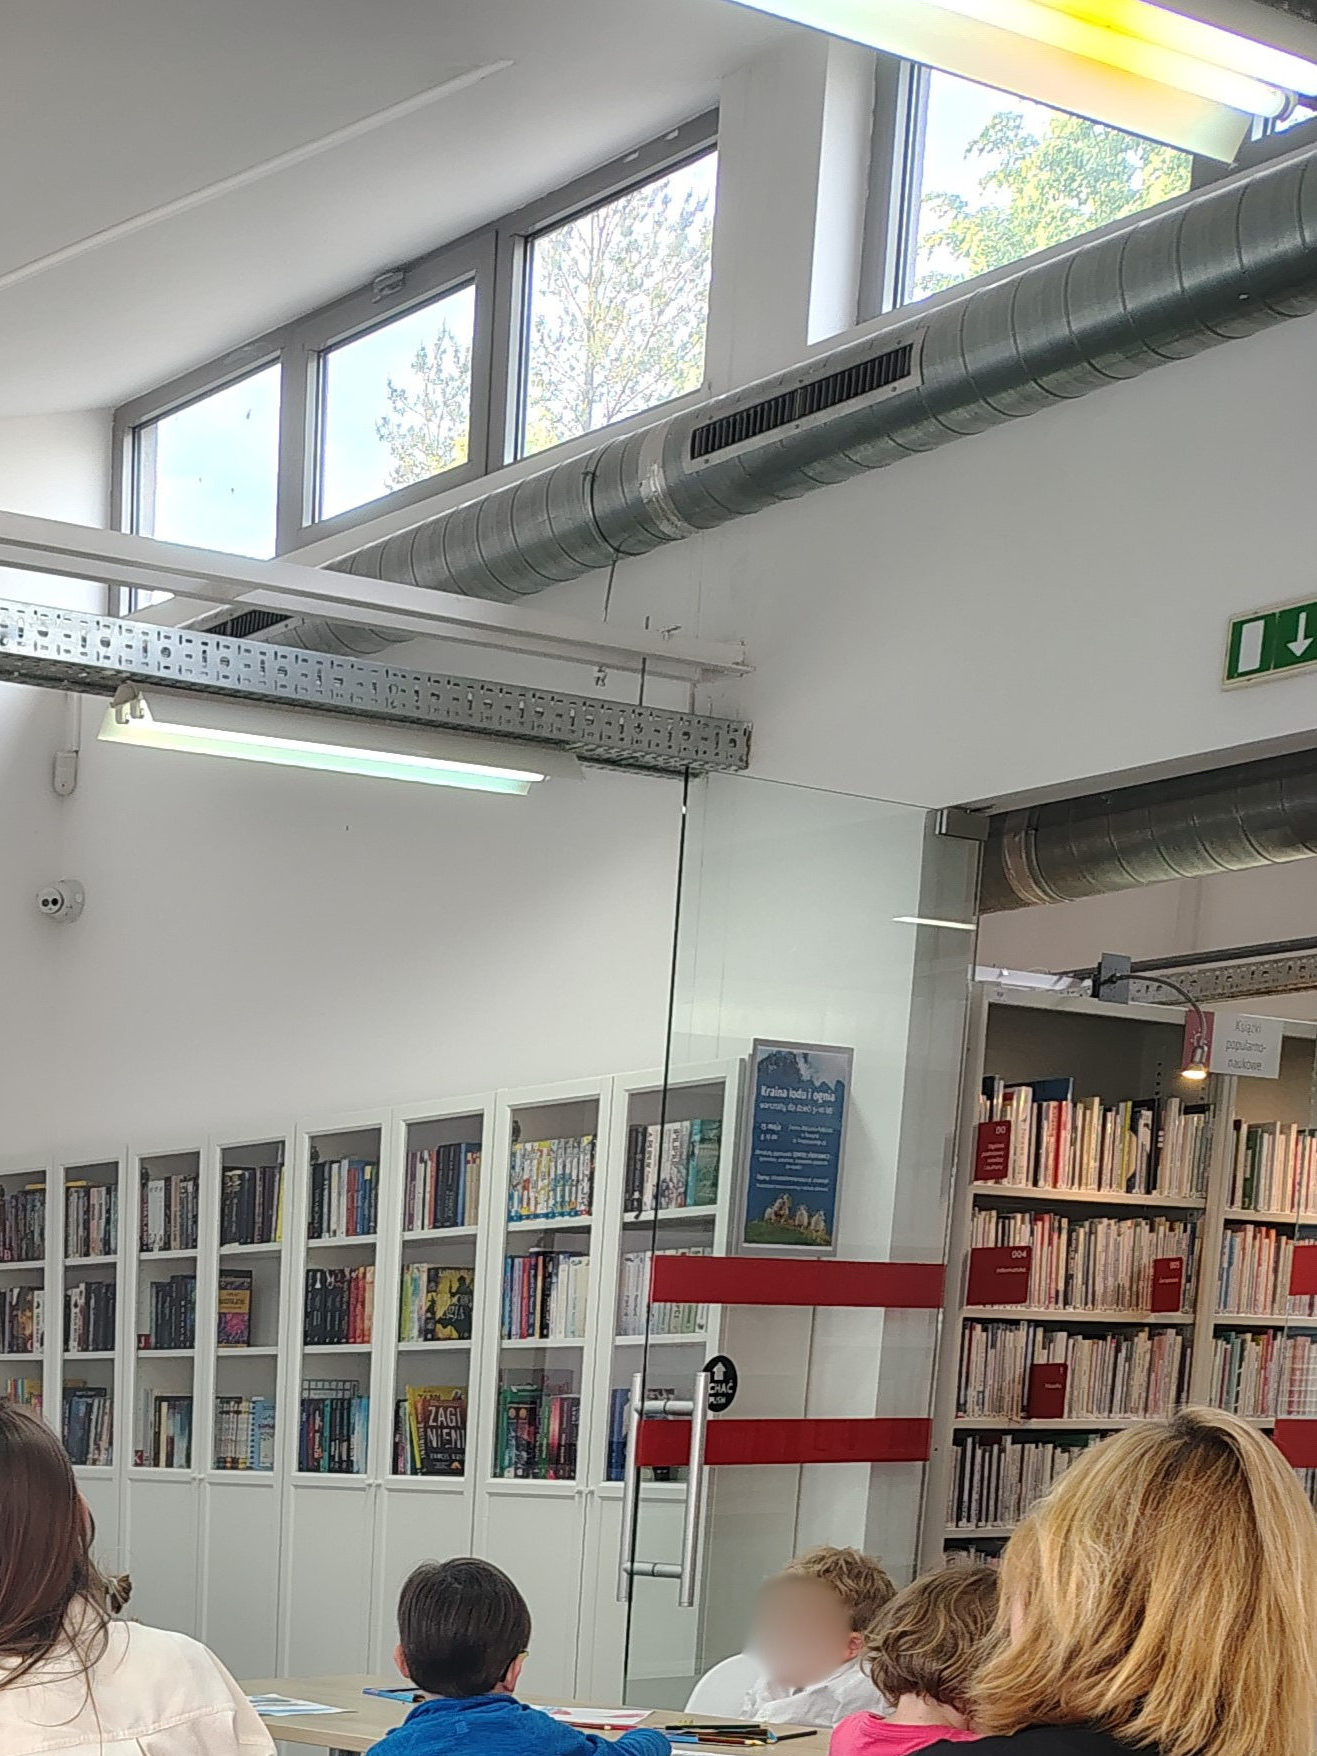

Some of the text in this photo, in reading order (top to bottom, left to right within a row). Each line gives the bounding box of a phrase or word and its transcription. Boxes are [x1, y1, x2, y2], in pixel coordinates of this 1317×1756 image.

[760, 1085, 788, 1098] Kraina
[813, 1089, 836, 1104] ognia
[708, 1380, 734, 1394] CHAĆ
[428, 1406, 461, 1427] ZAGI
